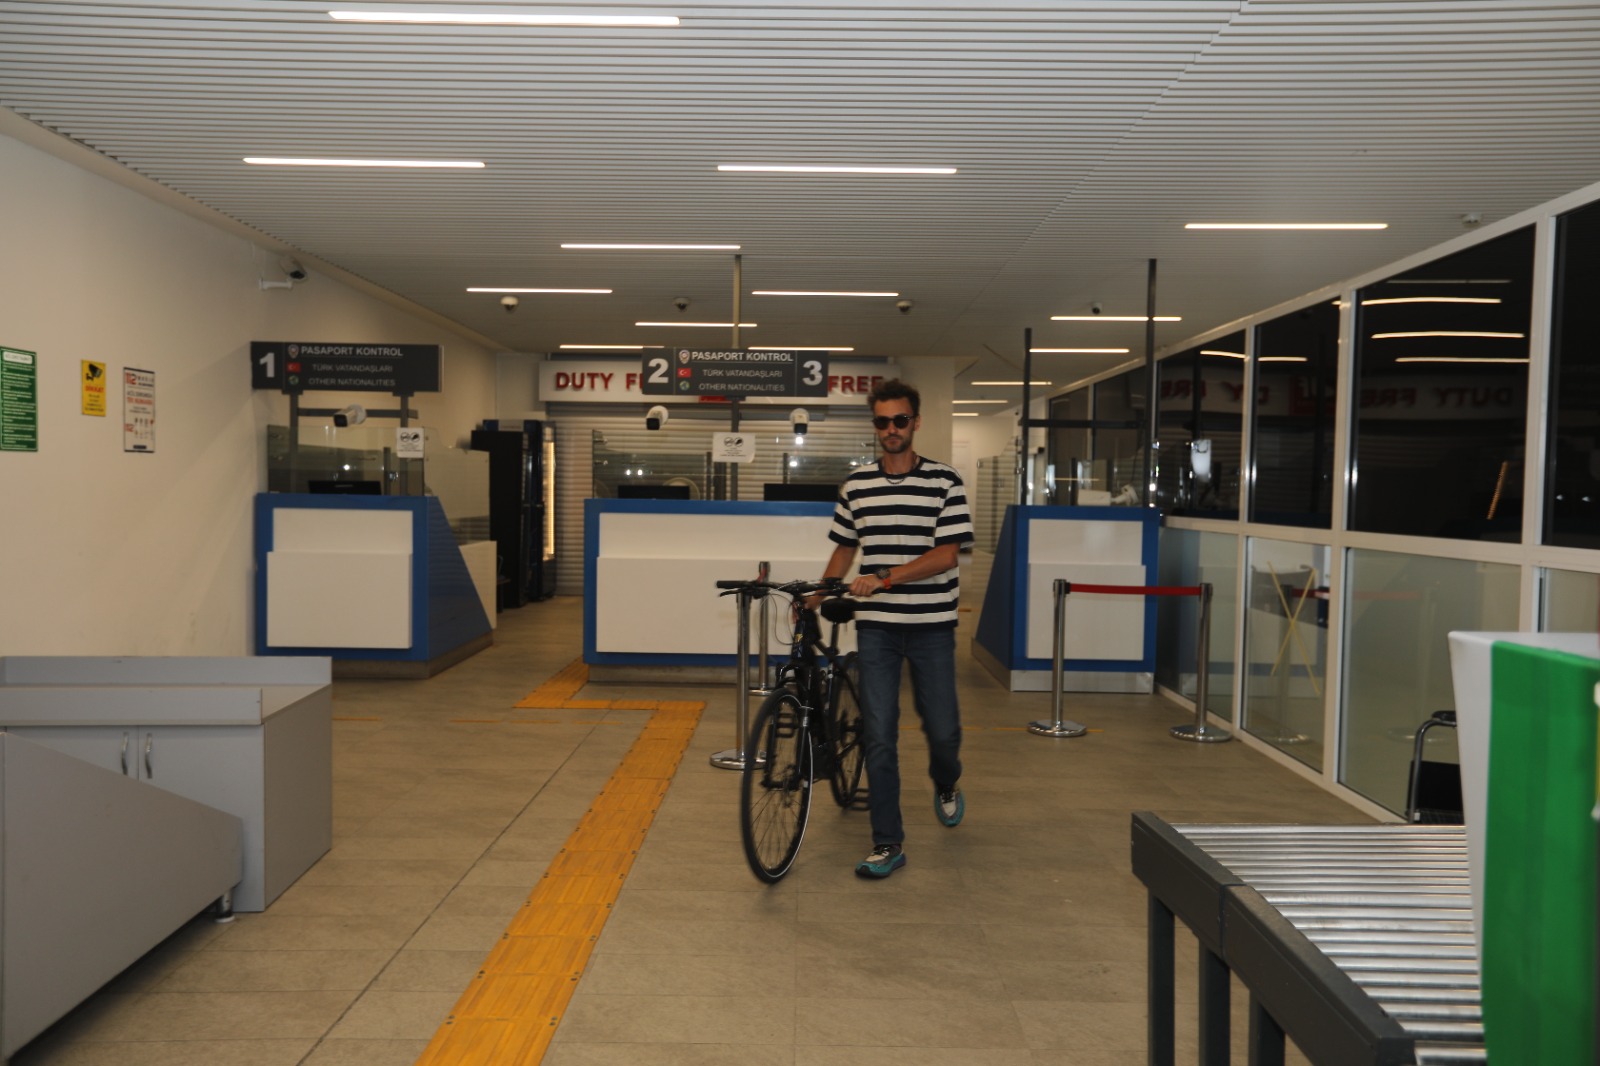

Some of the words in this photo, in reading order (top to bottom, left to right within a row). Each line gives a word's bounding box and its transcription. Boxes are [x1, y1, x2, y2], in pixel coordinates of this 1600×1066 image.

[301, 345, 353, 356] PASAPORT
[356, 346, 403, 357] KONTROL
[691, 351, 744, 361] PASAPORT
[746, 352, 793, 362] KONTROL
[259, 352, 275, 378] 1
[312, 363, 334, 372] TÜRK
[648, 358, 669, 384] 2
[702, 367, 724, 377] TÜRK
[725, 369, 783, 379] VATANDAŞLARI
[802, 360, 823, 386] 3
[308, 377, 336, 386] OTHER
[337, 378, 395, 387] NATIONALITIES
[555, 372, 613, 390] DUTY
[699, 383, 726, 391] OTHER
[727, 383, 785, 392] NATIONALITIES
